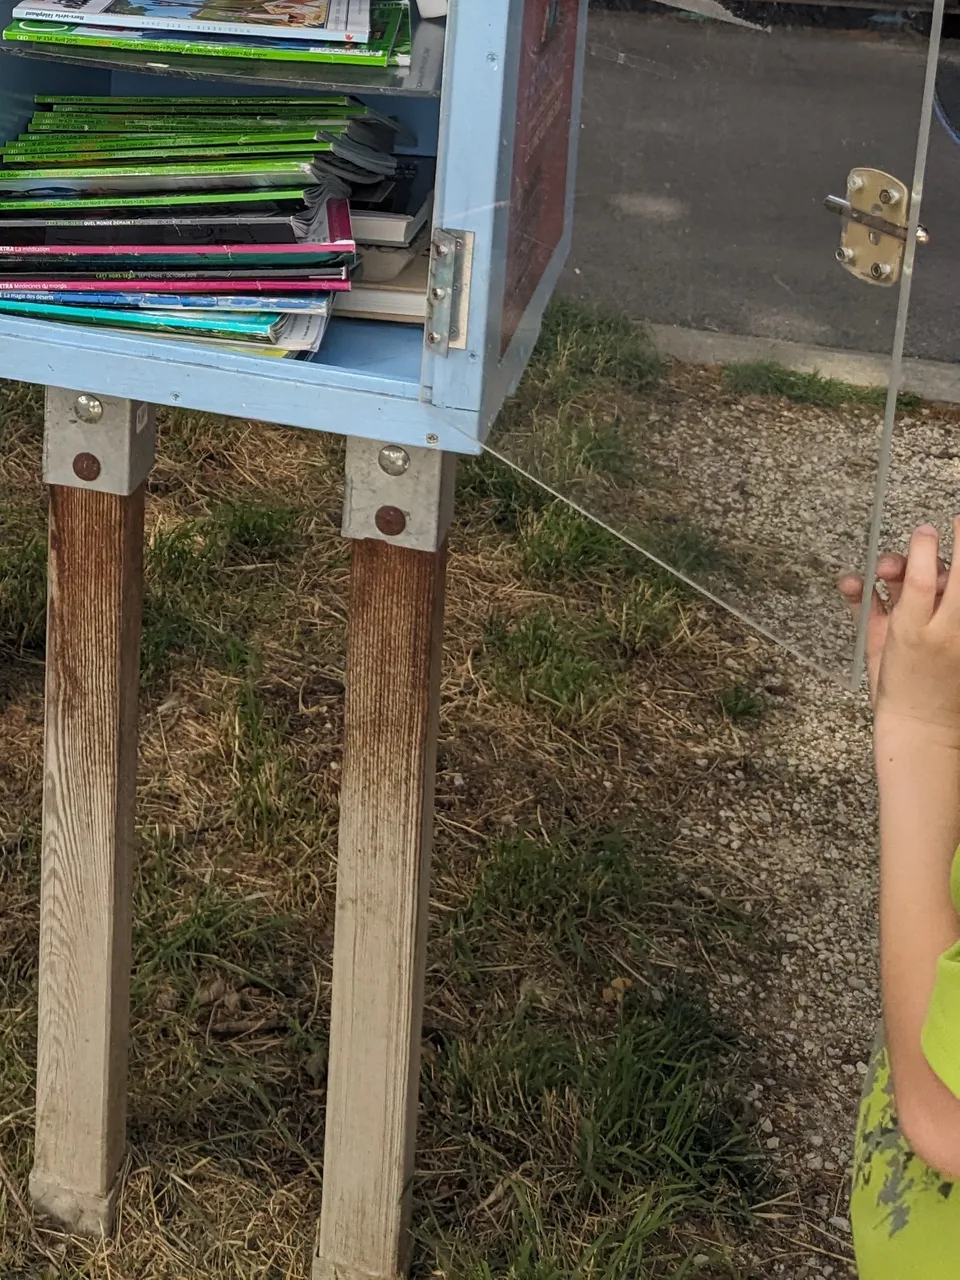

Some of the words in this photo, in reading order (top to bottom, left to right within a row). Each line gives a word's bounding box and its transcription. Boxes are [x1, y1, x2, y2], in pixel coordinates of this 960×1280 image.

[14, 282, 41, 290] Médecines
[42, 282, 49, 290] du
[11, 293, 26, 301] magie
[35, 293, 54, 301] déserts
